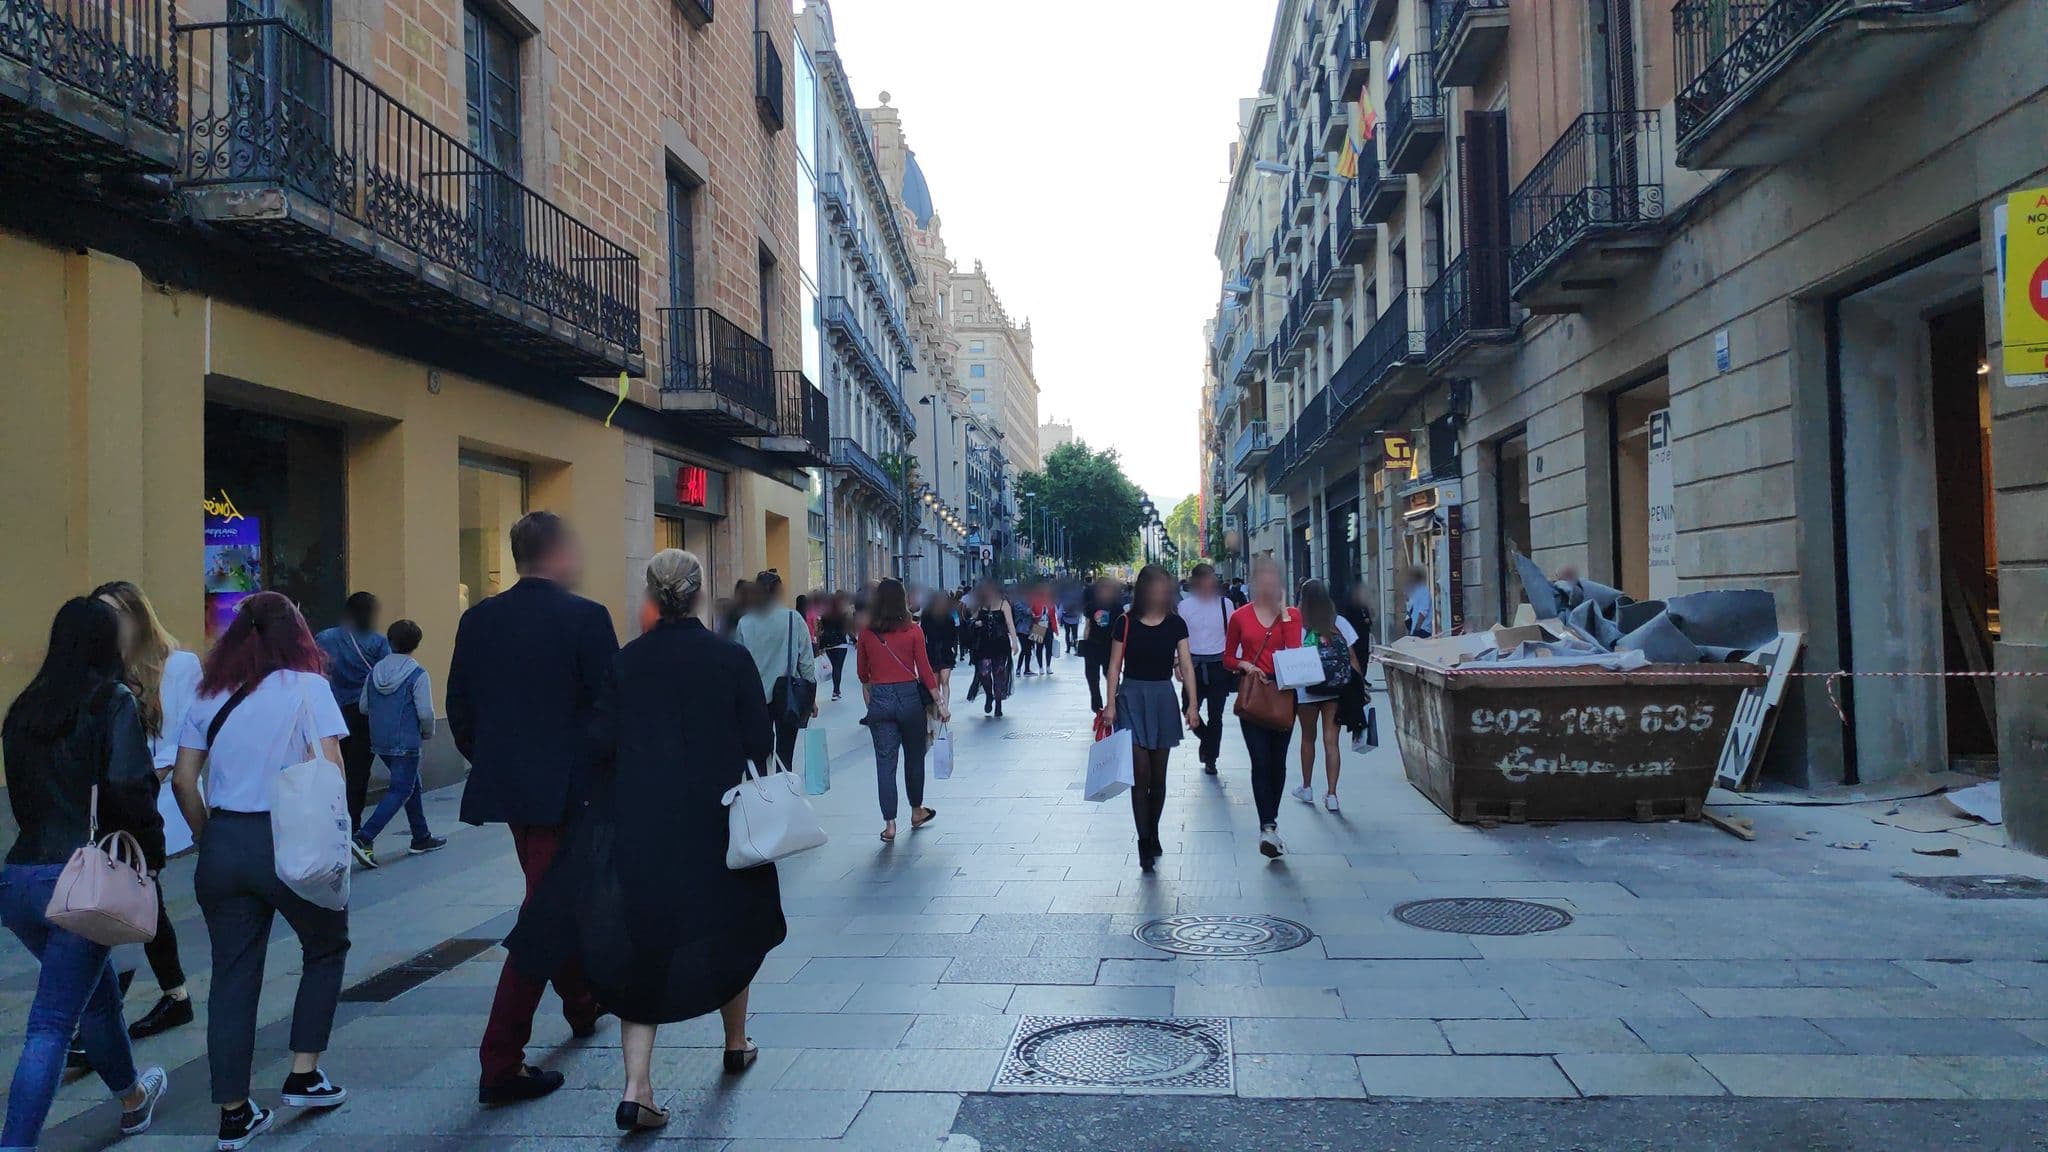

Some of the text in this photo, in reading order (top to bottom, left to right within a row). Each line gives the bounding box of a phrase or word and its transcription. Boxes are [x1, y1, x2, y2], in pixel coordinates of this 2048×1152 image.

[2037, 226, 2048, 235] C
[1471, 708, 1542, 735] 902
[1640, 704, 1715, 733] 635
